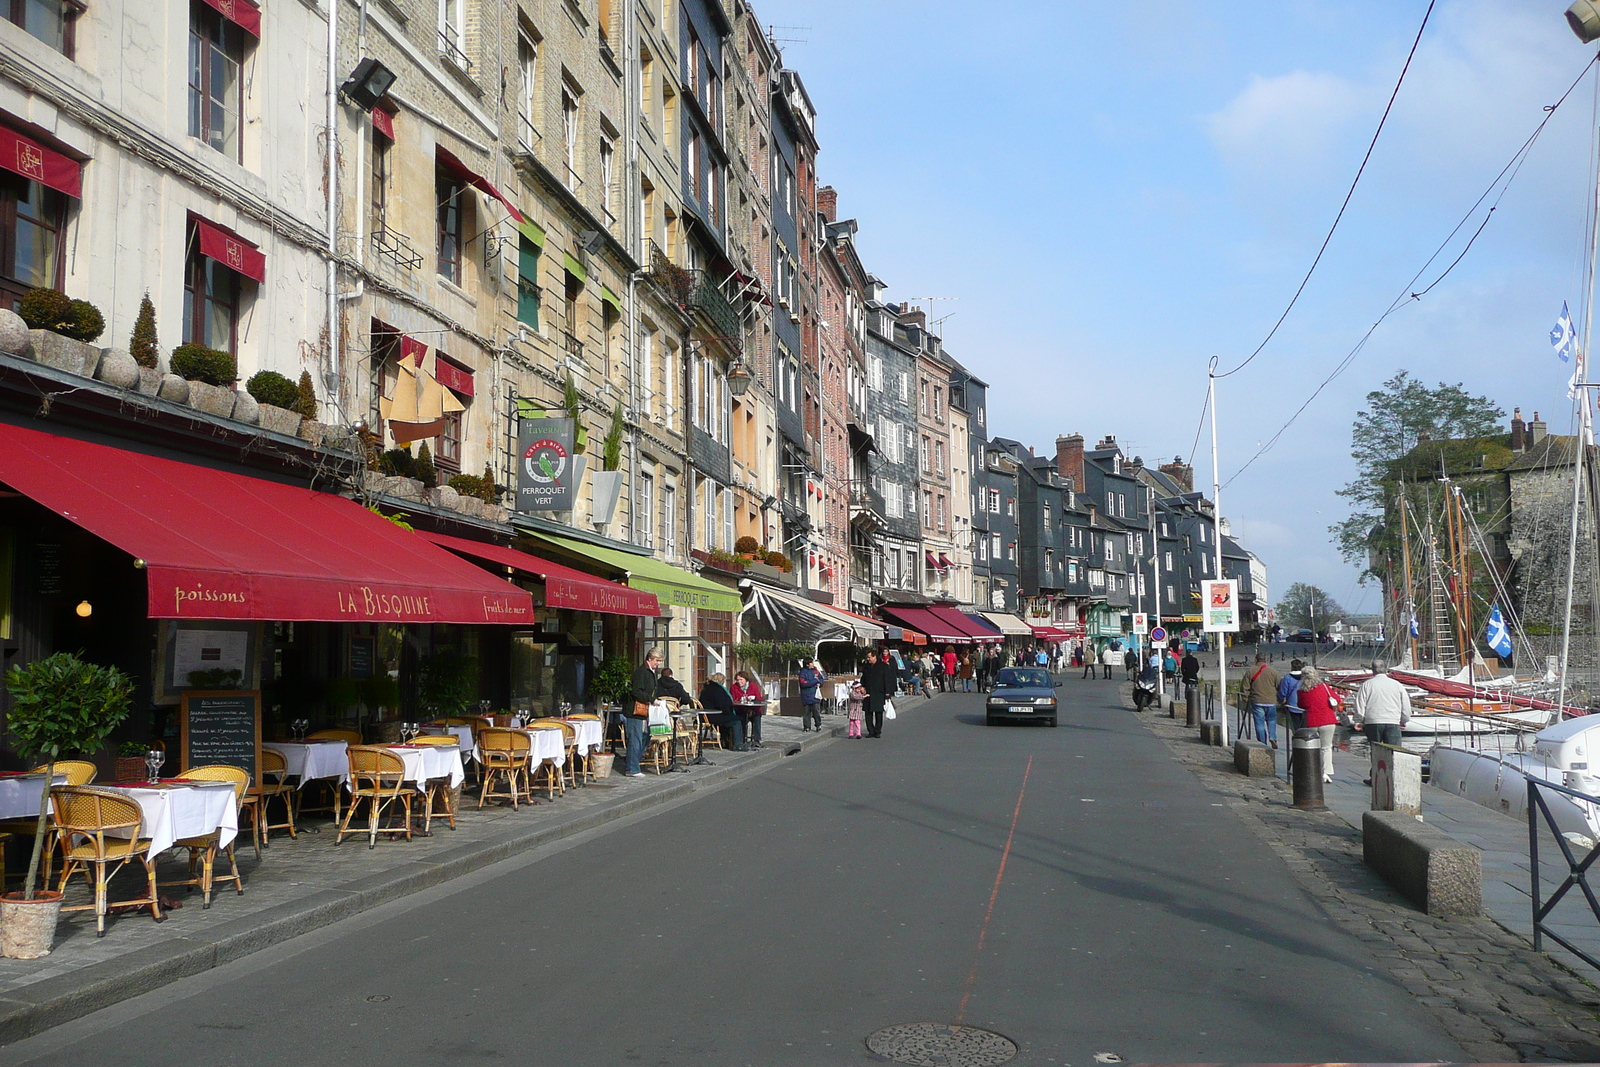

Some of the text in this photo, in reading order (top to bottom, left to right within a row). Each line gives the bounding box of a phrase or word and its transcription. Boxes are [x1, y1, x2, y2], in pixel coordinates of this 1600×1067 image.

[522, 487, 566, 495] PERROQUET
[175, 583, 246, 614] poissons
[338, 586, 432, 618] LA BISQUINE
